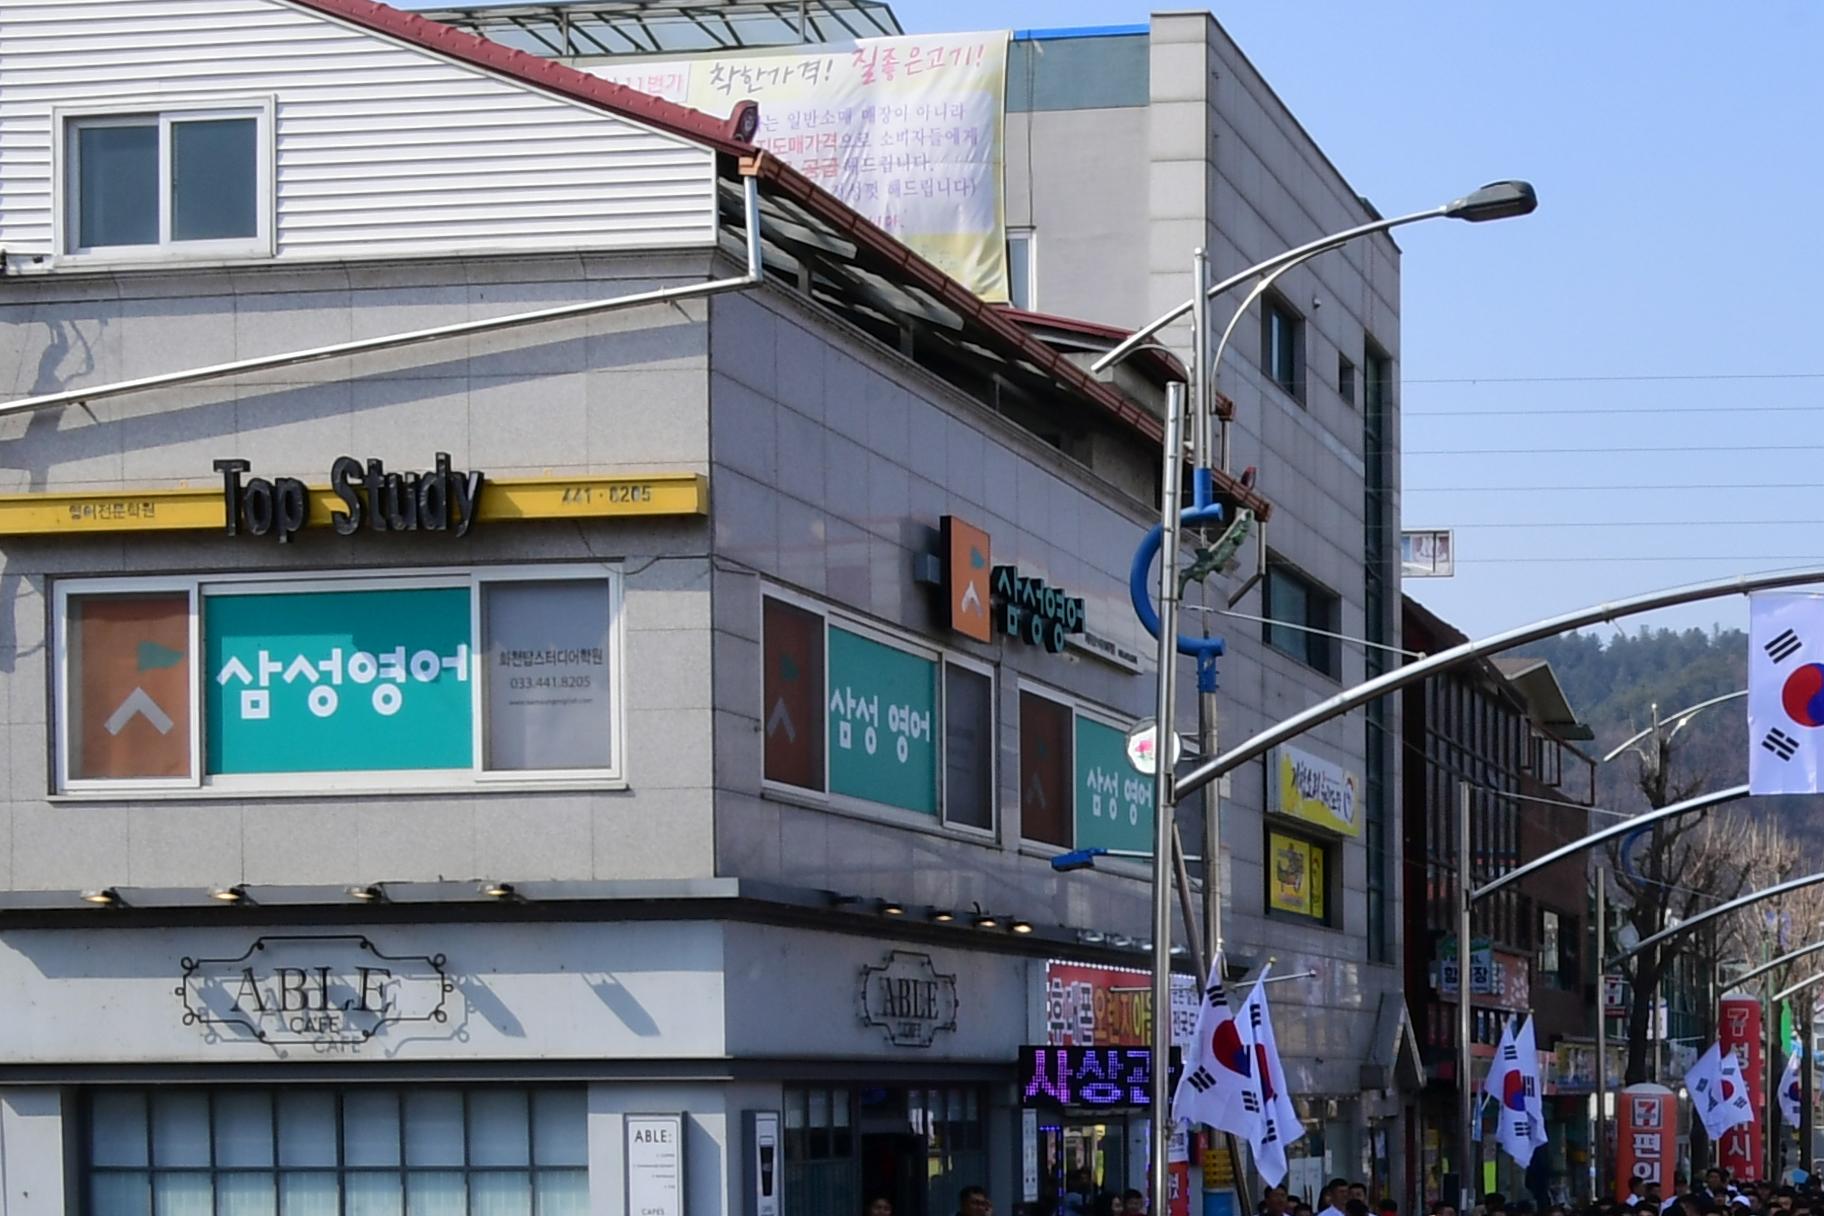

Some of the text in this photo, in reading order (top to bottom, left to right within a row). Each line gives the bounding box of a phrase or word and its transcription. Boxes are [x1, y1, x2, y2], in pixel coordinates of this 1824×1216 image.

[710, 59, 833, 95] 착한가격!
[213, 451, 484, 544] Top Study
[996, 566, 1086, 653] 삼성영어
[217, 643, 469, 721] 삼성영어
[231, 966, 393, 1013] ABLE
[879, 976, 939, 1021] ABLE
